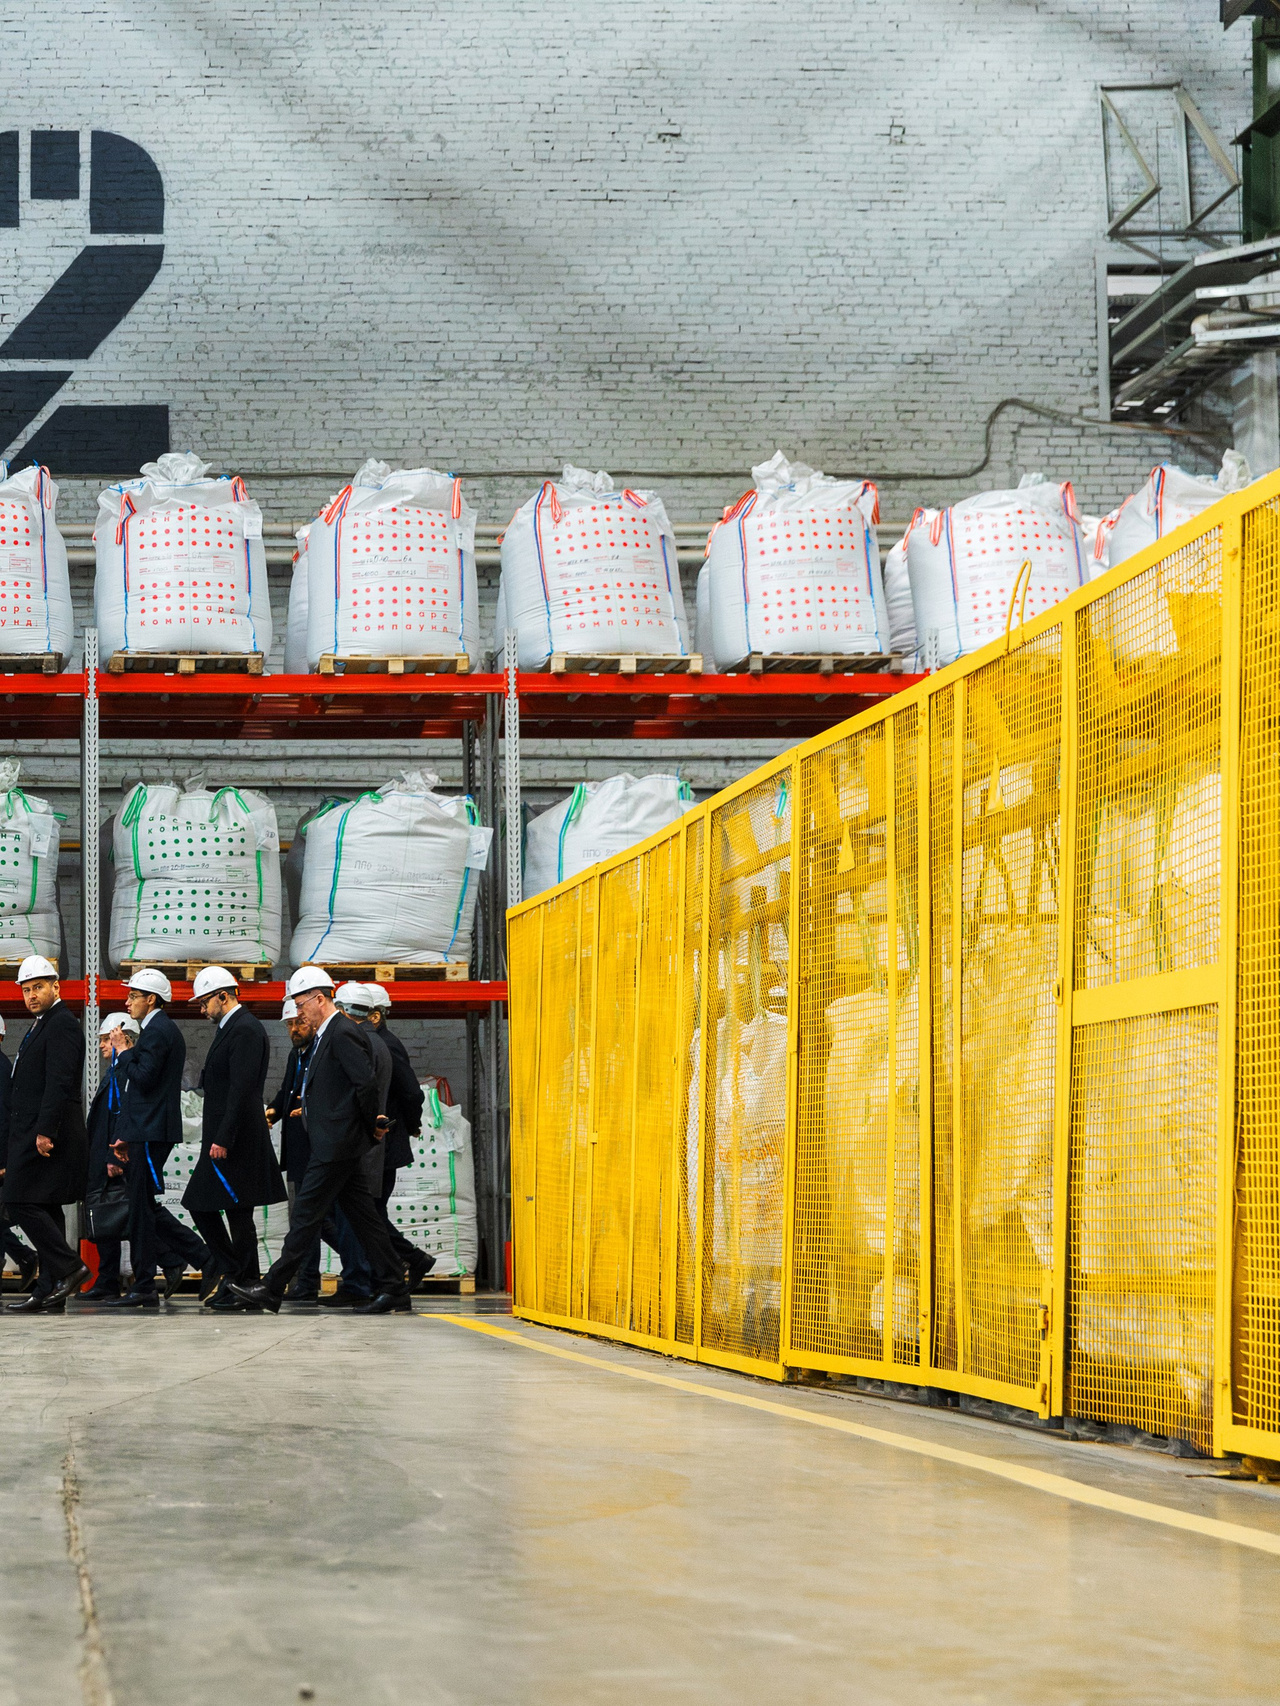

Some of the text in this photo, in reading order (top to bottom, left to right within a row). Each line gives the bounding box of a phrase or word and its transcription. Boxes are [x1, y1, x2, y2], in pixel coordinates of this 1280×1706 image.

[1, 605, 32, 614] арс
[206, 605, 235, 614] арс
[633, 606, 661, 614] арс
[419, 611, 448, 620] арс
[832, 610, 860, 619] арс
[140, 617, 237, 626] компаунд
[567, 619, 664, 630] компаунд
[352, 624, 448, 633] компаунд
[765, 623, 862, 634] компаунд
[148, 814, 178, 823] арс
[217, 915, 246, 923] арс
[151, 927, 246, 936] компаунд
[412, 1229, 441, 1237] арс
